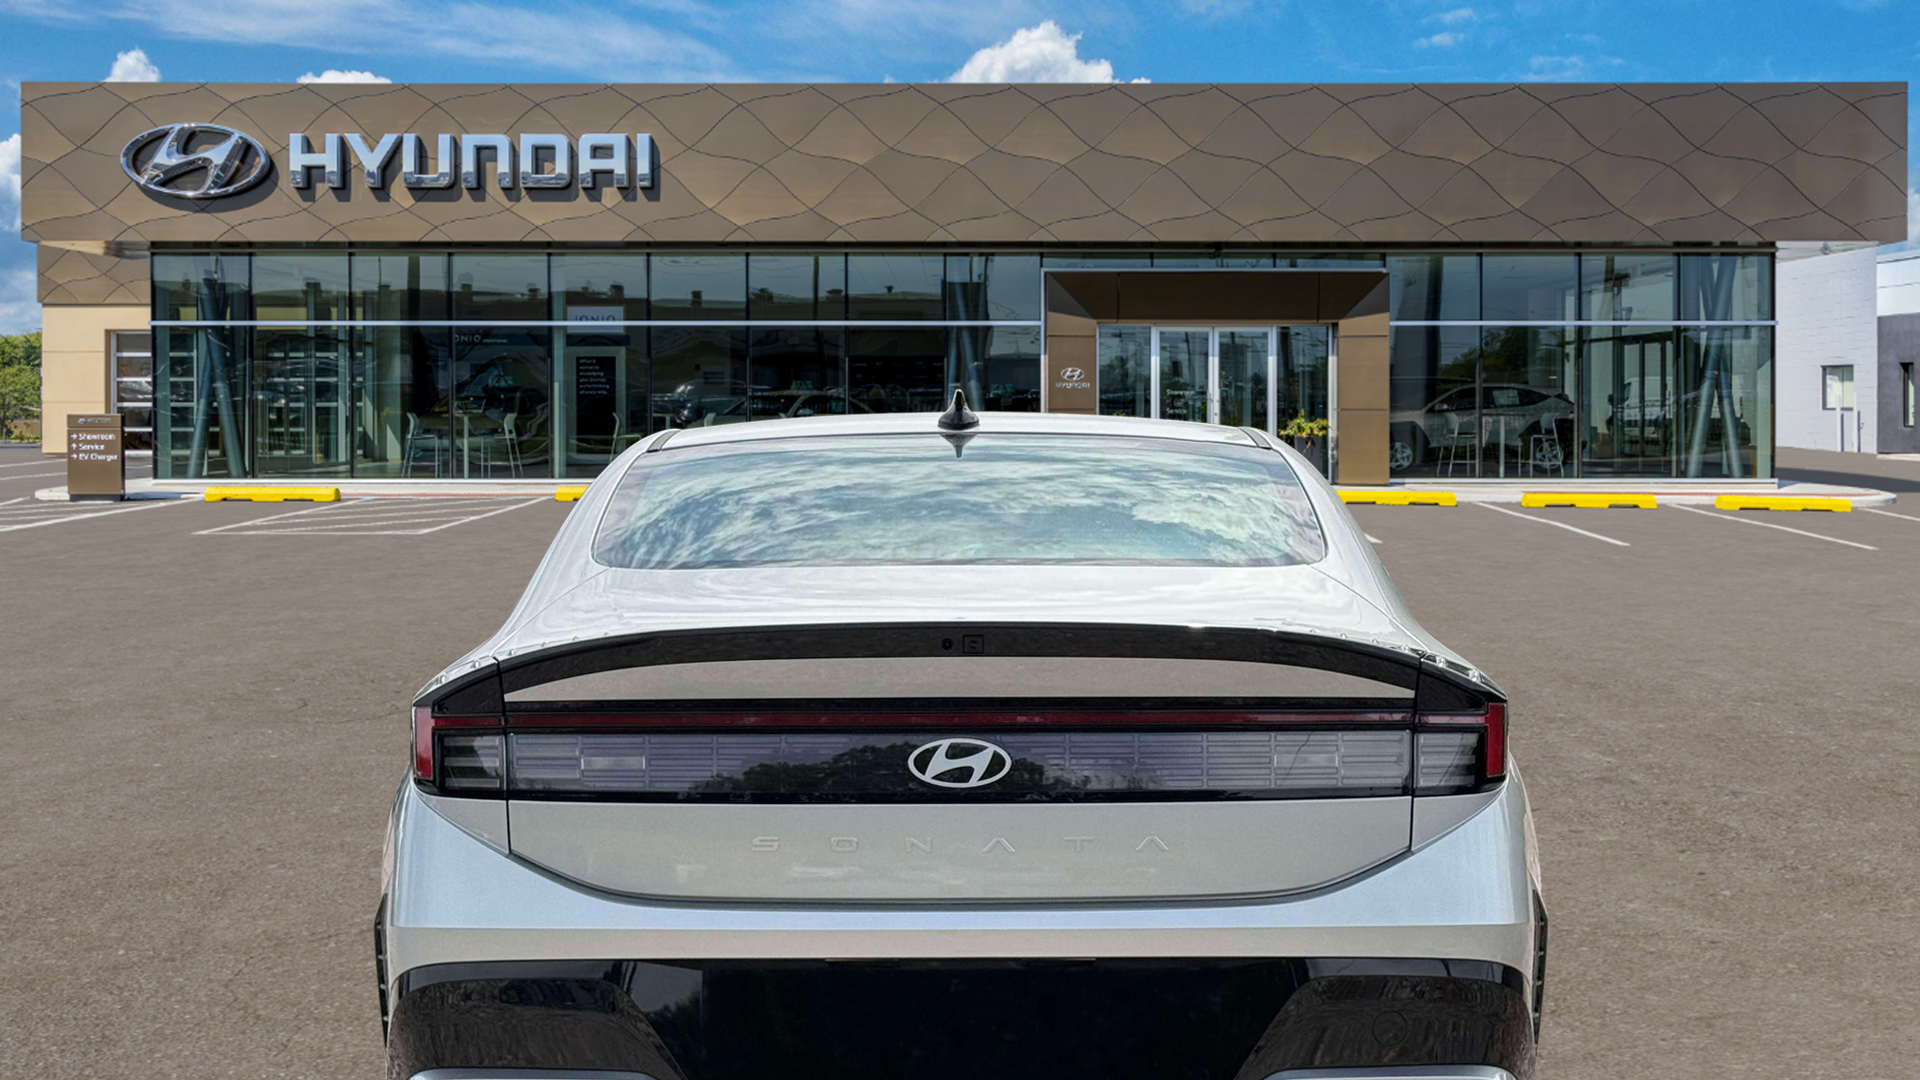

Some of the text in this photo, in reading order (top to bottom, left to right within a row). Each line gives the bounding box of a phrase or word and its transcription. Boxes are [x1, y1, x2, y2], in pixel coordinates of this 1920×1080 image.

[288, 132, 657, 189] HYUNDAI
[78, 433, 116, 441] Showroom
[78, 443, 105, 451] Service
[90, 453, 118, 462] Charger
[751, 836, 1169, 854] SONATA
